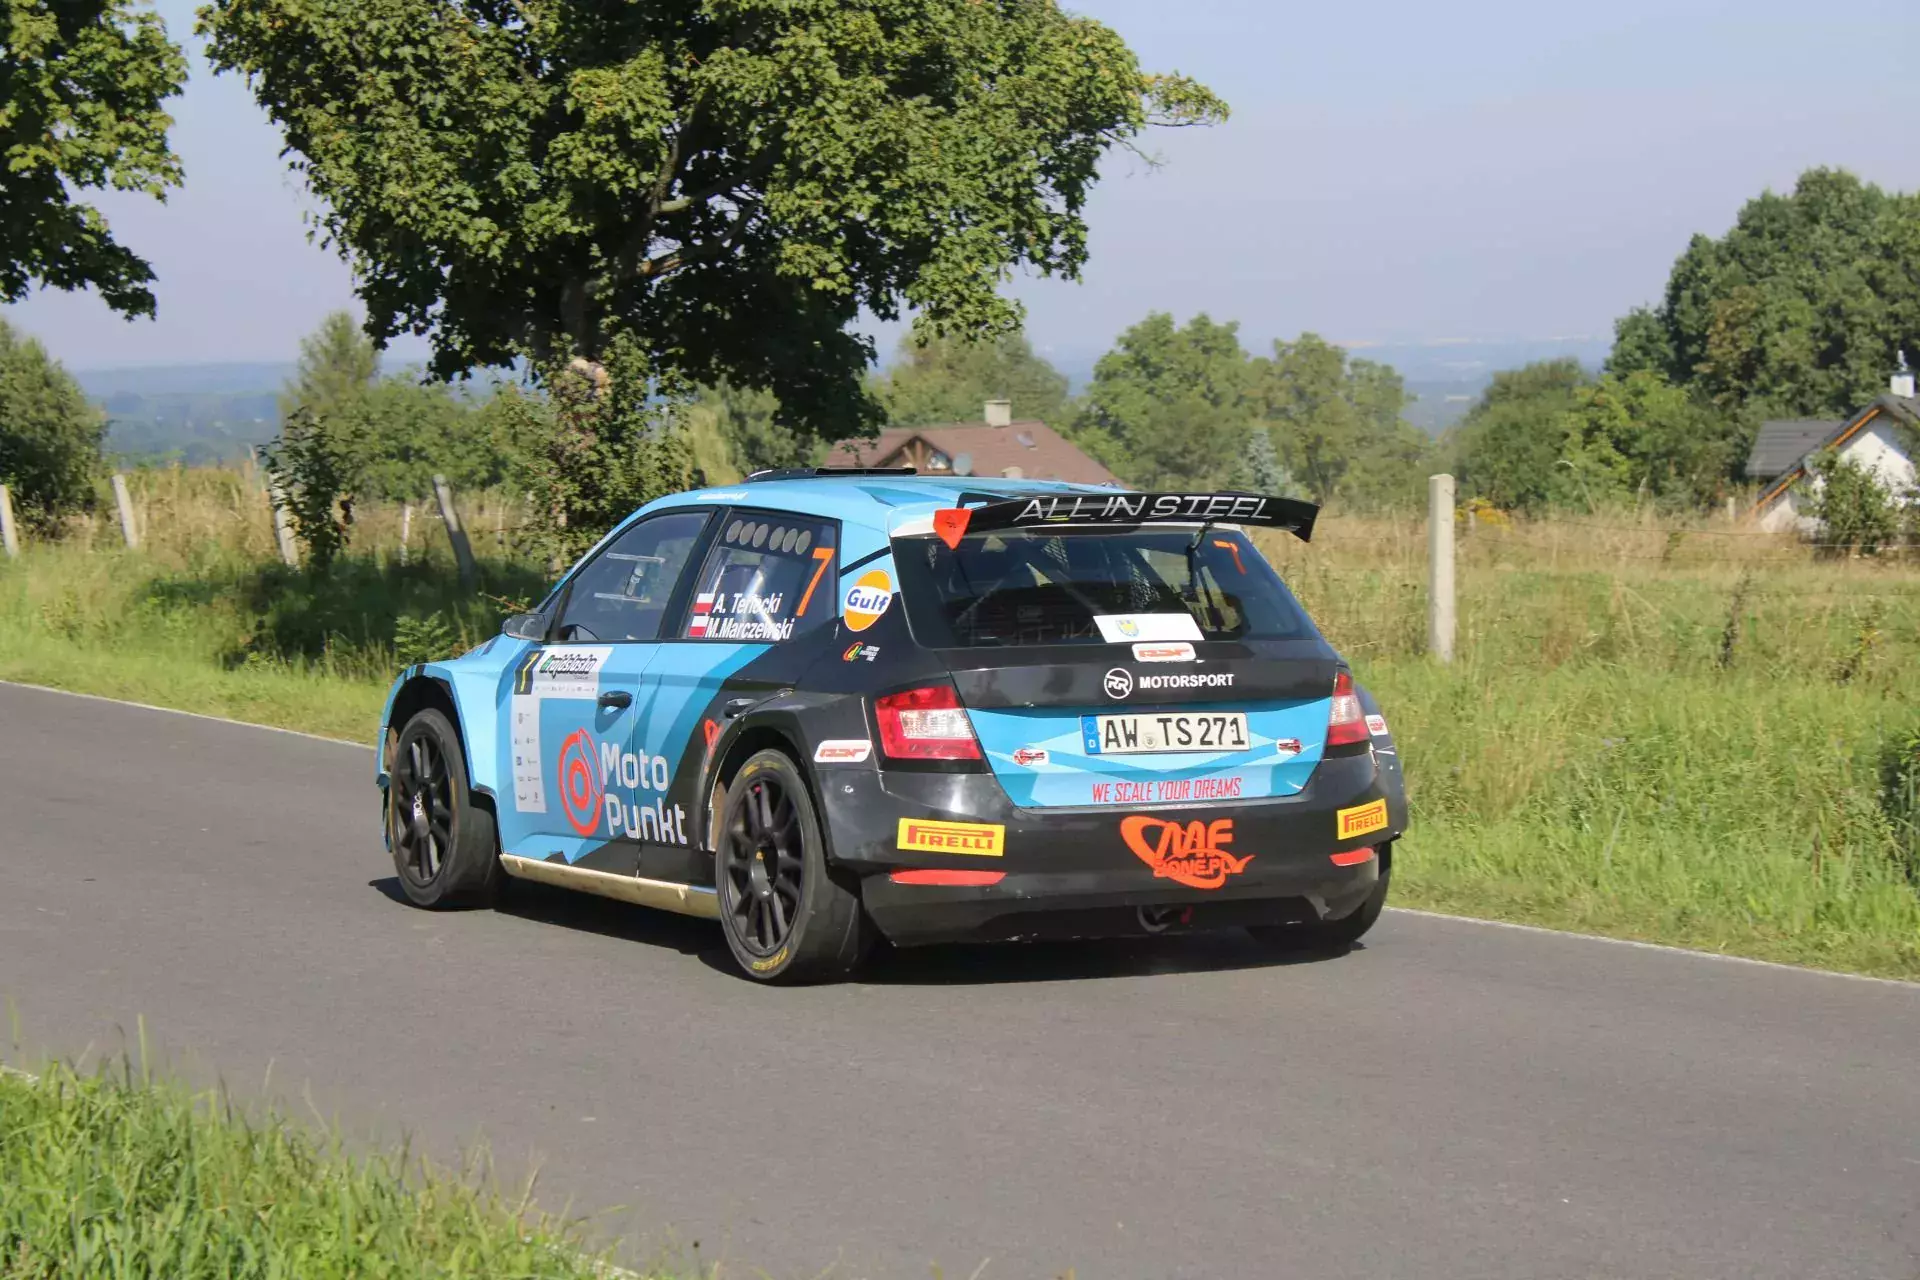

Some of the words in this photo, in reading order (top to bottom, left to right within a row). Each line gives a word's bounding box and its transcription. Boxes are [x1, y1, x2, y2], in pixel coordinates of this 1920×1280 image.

[1013, 497, 1091, 522] ALL
[1101, 495, 1147, 517] IN
[1150, 495, 1273, 520] STEEL
[1212, 538, 1247, 576] 7
[796, 547, 836, 617] 7
[712, 592, 727, 614] A.
[847, 588, 889, 611] Gulf
[1139, 674, 1235, 689] MOTORSPORT
[1105, 718, 1138, 748] AW
[601, 742, 669, 792] Moto
[1092, 782, 1110, 803] WE
[1114, 781, 1153, 802] SCALE
[1157, 780, 1191, 800] YOUR
[1193, 777, 1242, 799] DREAMS
[604, 793, 688, 845] Punkt
[1344, 806, 1383, 833] PIRELLI
[907, 825, 994, 850] PIRELLI
